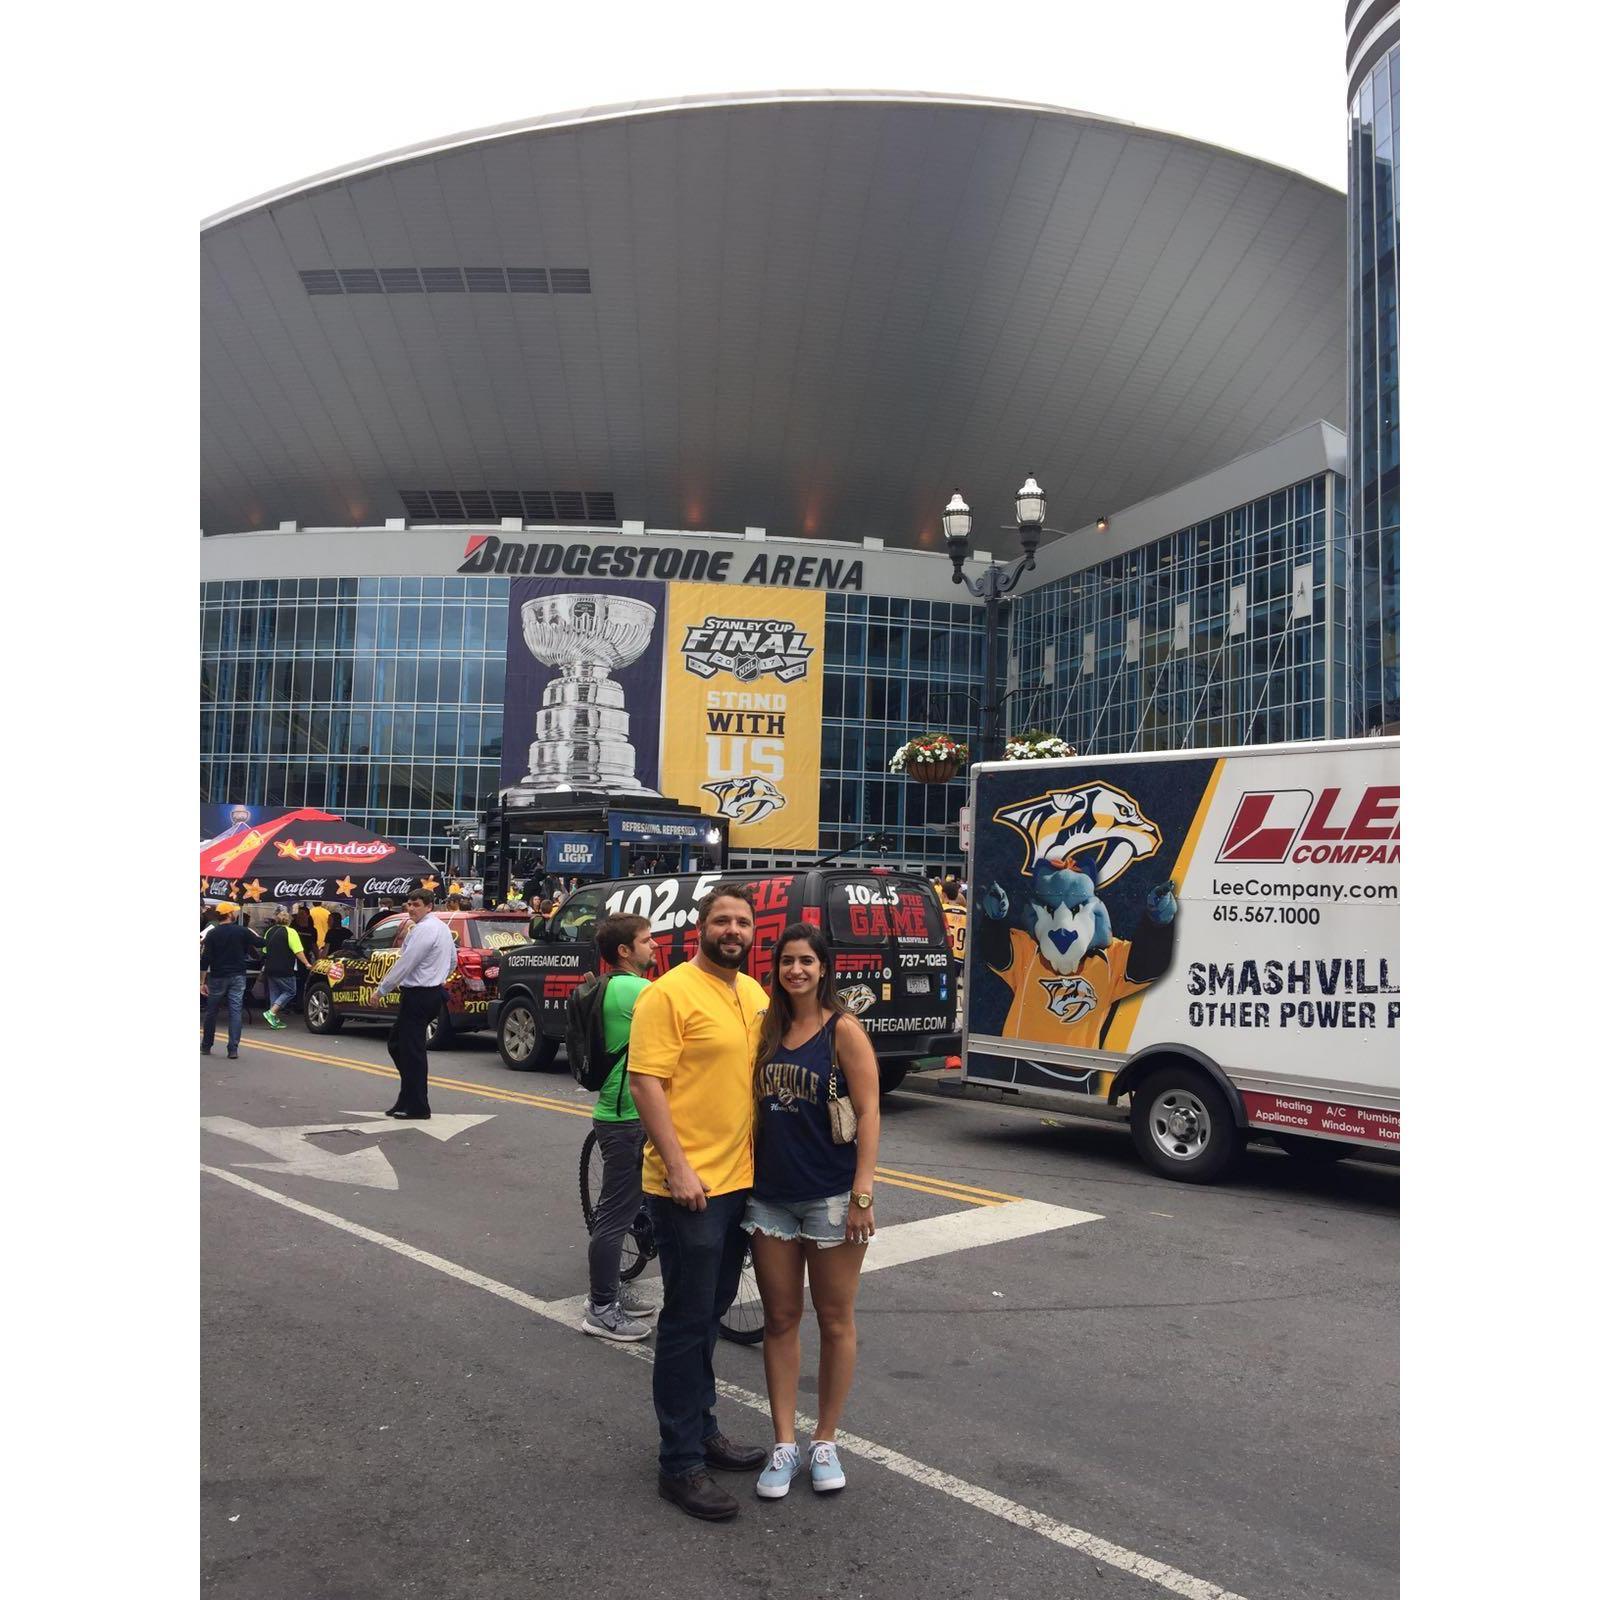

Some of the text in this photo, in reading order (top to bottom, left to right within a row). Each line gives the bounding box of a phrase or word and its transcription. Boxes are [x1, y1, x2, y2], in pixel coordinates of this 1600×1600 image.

[457, 535, 863, 590] BRIDGESTONE ARENA
[705, 619, 793, 632] STANLEY CUP
[684, 628, 814, 656] FINAL
[738, 660, 757, 677] NHL
[707, 690, 786, 711] STAND
[707, 712, 785, 734] WITH
[705, 736, 785, 782] US
[1300, 786, 1400, 841] LE
[295, 840, 391, 857] Hardee's
[559, 853, 593, 863] LIGHT
[563, 843, 589, 854] BUD
[744, 875, 795, 911] HE
[844, 884, 899, 905] 102.5
[899, 893, 924, 906] THE
[1212, 879, 1398, 902] LeeCompany.com
[849, 905, 929, 937] GAME
[1213, 905, 1320, 925] 615.567.1000
[897, 936, 929, 944] NASHVILLE
[508, 955, 580, 967] 1025THEGAME.COM
[834, 954, 883, 972] ESPN
[899, 954, 948, 968] 737-1025
[836, 971, 880, 980] RADIO
[543, 975, 586, 998] ESP
[860, 1016, 947, 1032] THEGAME.COM
[1188, 1001, 1270, 1028] OTHER
[1280, 1001, 1376, 1028] POWER
[1275, 1098, 1313, 1114] Heating
[1326, 1106, 1347, 1118] A/C
[1255, 1109, 1309, 1126] Appliances
[1321, 1118, 1366, 1135] Windows
